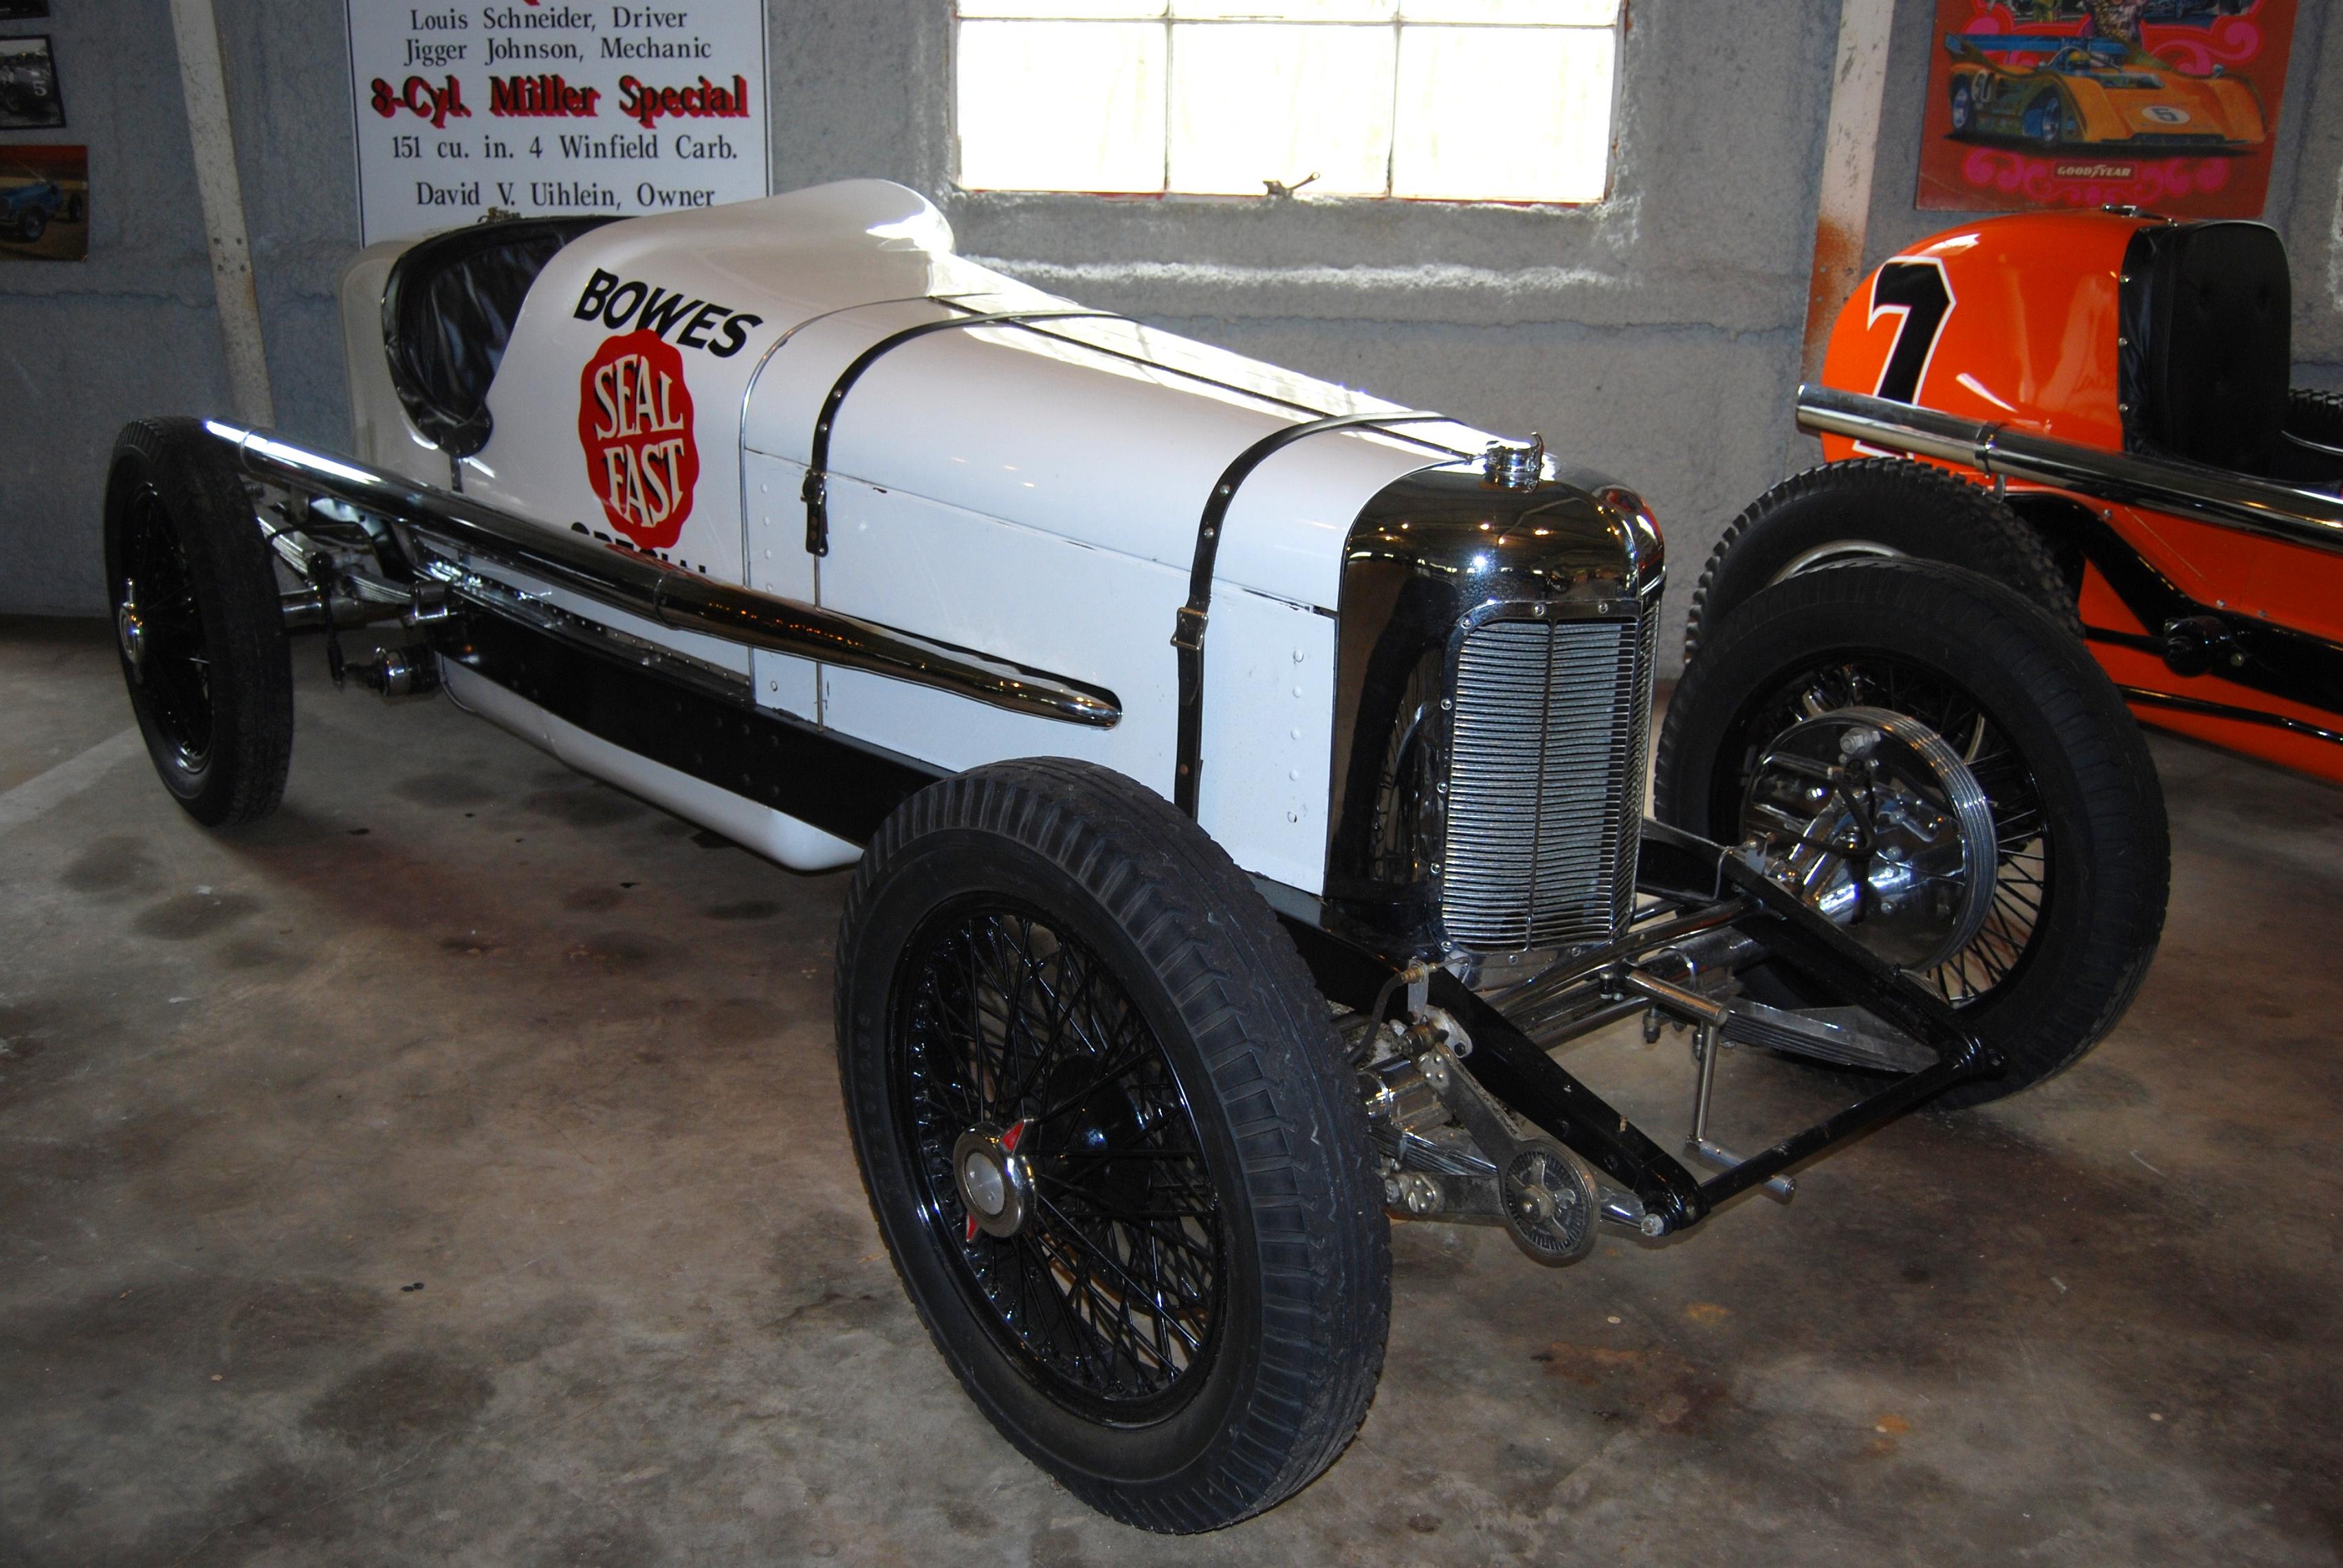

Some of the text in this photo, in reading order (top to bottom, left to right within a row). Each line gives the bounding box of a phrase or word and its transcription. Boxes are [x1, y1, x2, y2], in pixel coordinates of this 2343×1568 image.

[410, 6, 688, 32] Louis Schneider, Driver
[403, 36, 711, 66] Jigger Johnson, Mechanic
[370, 74, 750, 130] 8-Cyl. Miller Special
[392, 134, 737, 159] 151 cu. in. 4 Winfield Carb.
[2056, 164, 2131, 178] GOODYEAR
[416, 181, 714, 210] David V. Uihlein, Owner
[573, 267, 764, 357] BOWES
[593, 353, 684, 441] SEAL
[602, 438, 685, 529] FAST
